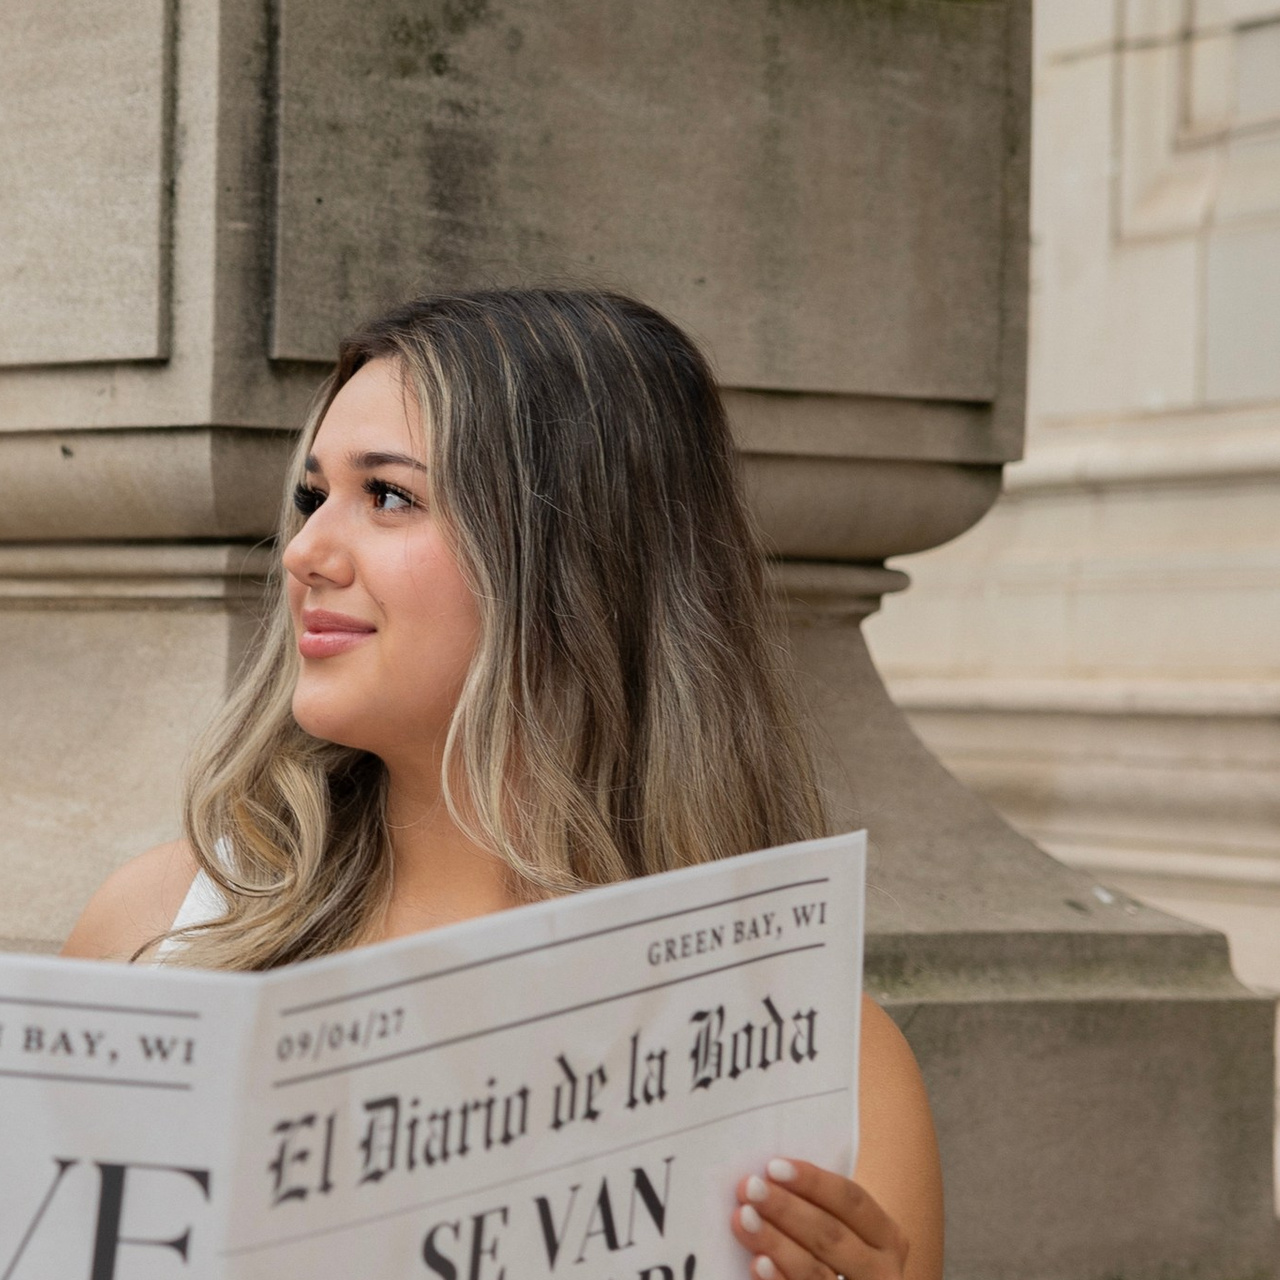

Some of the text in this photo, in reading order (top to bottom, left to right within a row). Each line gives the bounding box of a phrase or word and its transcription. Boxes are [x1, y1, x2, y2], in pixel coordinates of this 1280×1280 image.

[648, 901, 827, 967] GREEN BAY, WI
[24, 1027, 119, 1063] BAY,
[139, 1035, 196, 1065] WI
[276, 1009, 405, 1062] 09/04/27
[267, 997, 819, 1207] El Diario de la Boda
[532, 1156, 676, 1273] VAN
